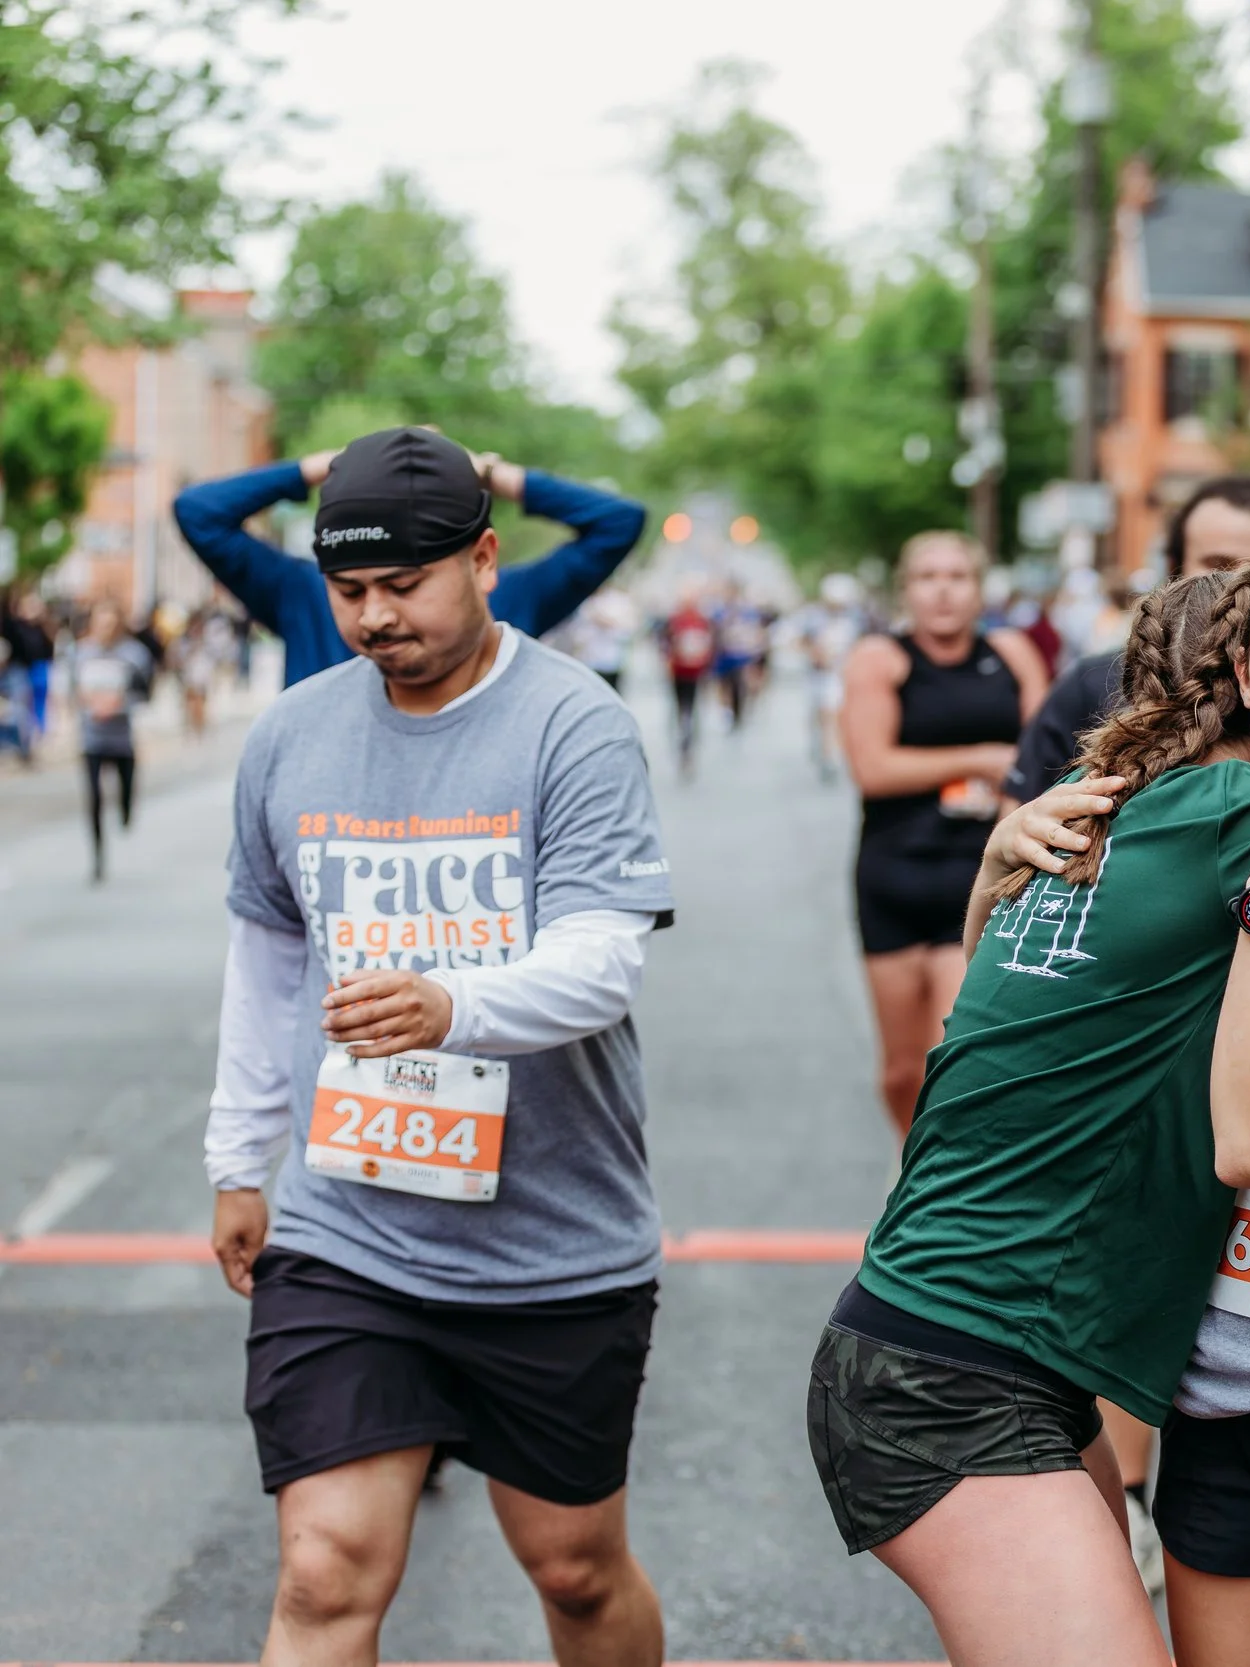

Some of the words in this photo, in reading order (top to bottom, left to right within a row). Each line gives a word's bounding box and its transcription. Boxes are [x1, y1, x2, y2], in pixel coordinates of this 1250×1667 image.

[297, 813, 328, 836] 28
[334, 813, 405, 838] Years
[409, 808, 520, 838] Running!
[326, 851, 524, 915] race
[336, 912, 517, 958] against
[329, 1096, 479, 1165] 2484
